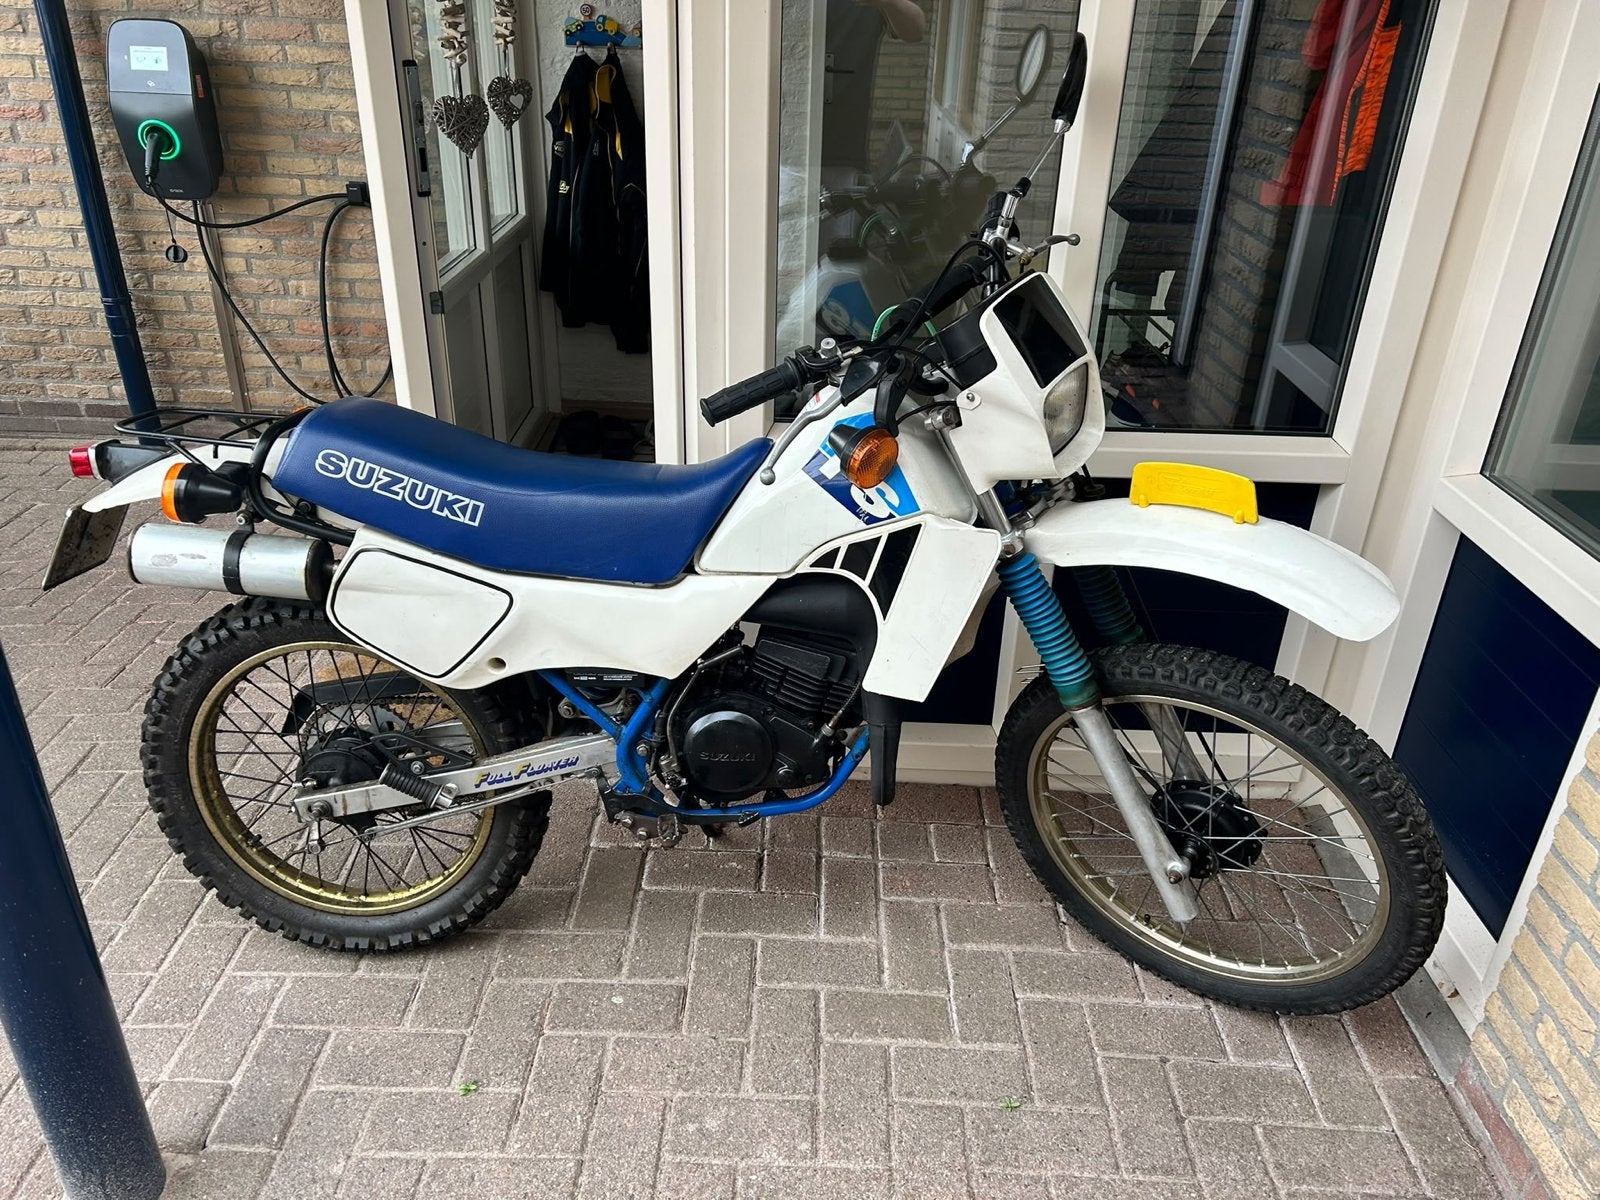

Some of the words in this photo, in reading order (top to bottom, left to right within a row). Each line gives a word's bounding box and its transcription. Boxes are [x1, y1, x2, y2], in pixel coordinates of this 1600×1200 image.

[582, 6, 590, 14] 50
[315, 449, 485, 527] SUZUKI
[700, 751, 756, 762] SUZUKI
[474, 770, 514, 788] FULL
